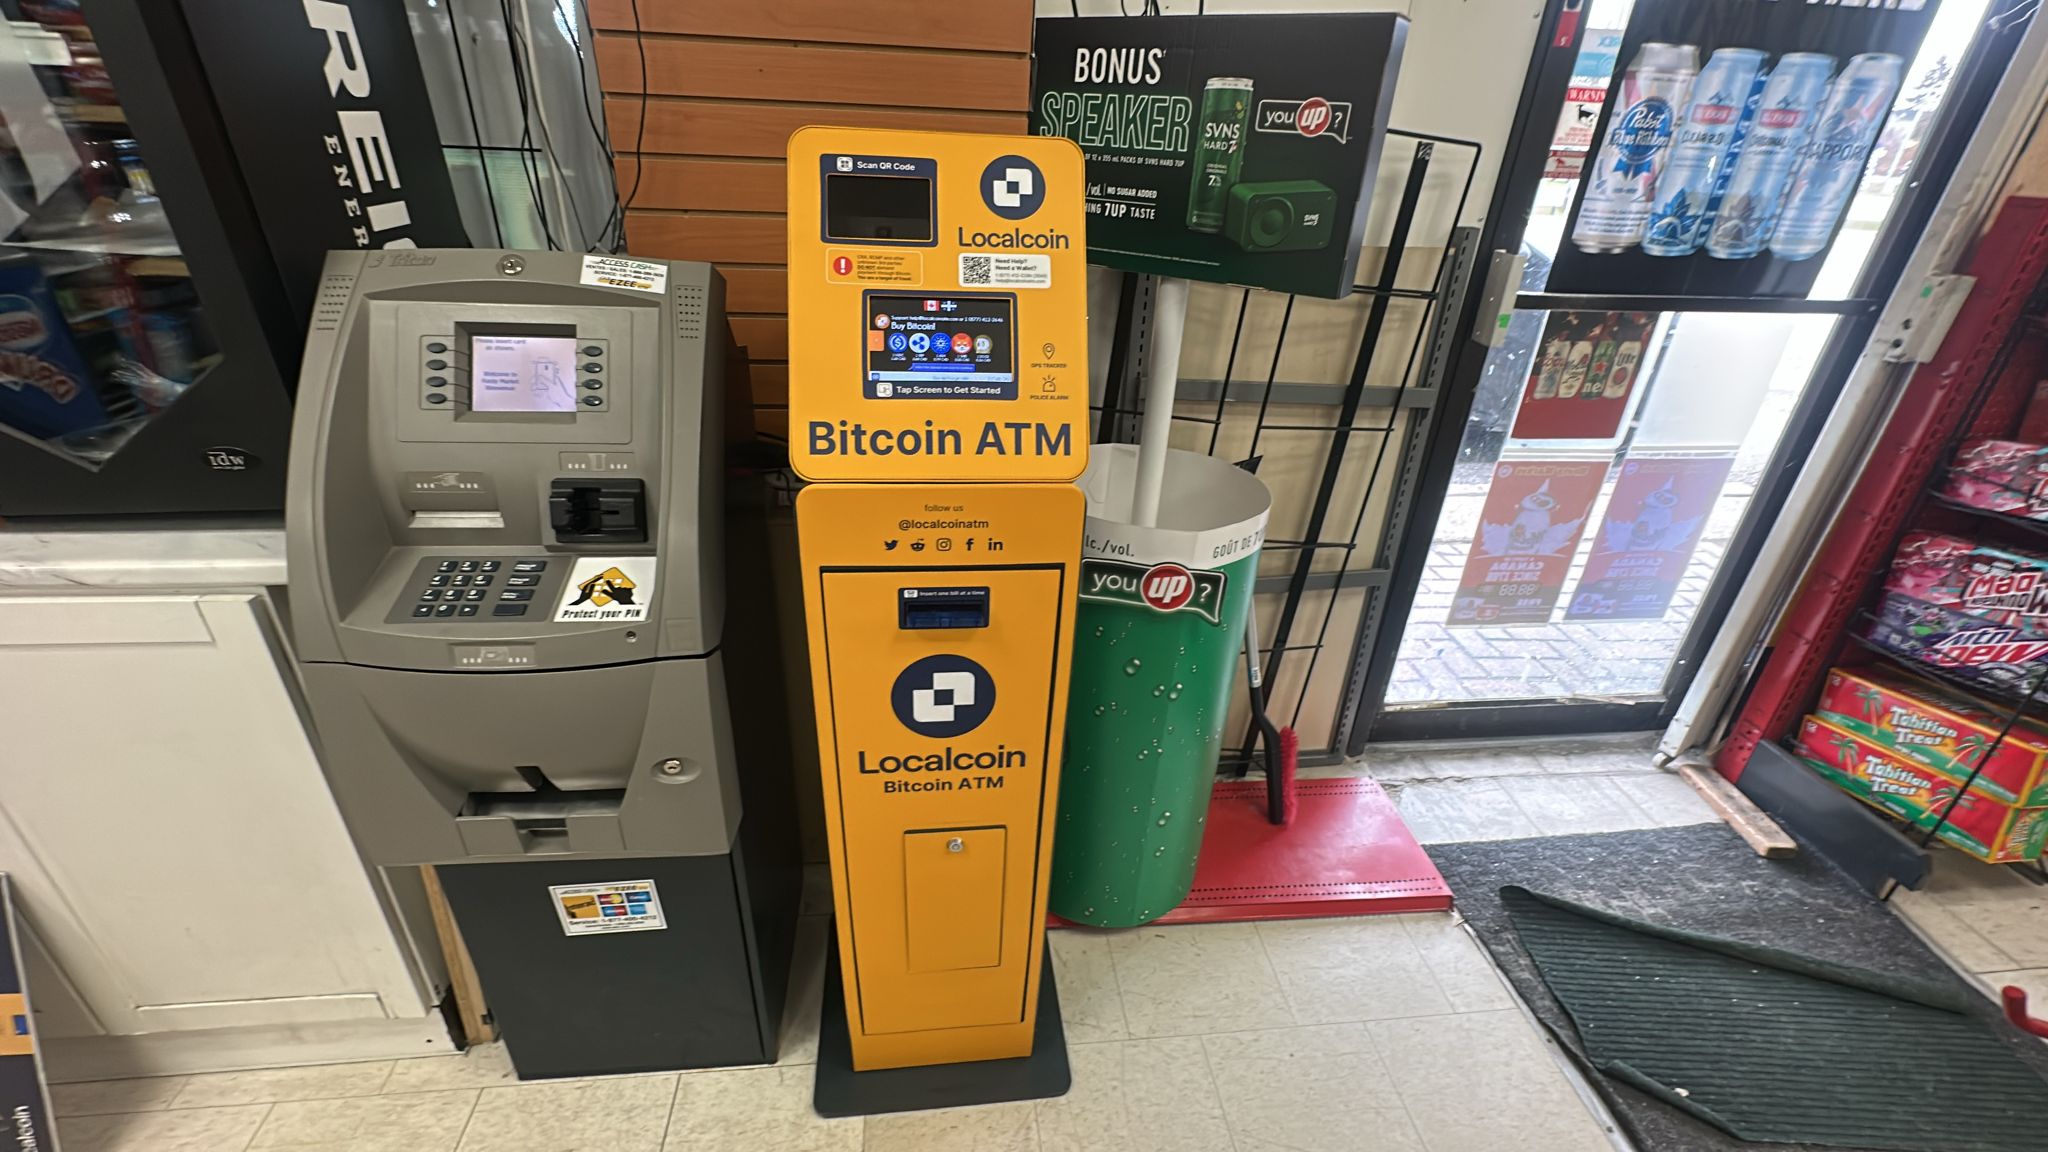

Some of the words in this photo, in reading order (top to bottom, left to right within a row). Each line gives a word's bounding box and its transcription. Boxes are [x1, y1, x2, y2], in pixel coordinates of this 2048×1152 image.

[1040, 91, 1193, 152] SPEAKER
[1264, 111, 1294, 127] you
[1301, 107, 1327, 131] up
[1204, 123, 1240, 139] SVNS
[1204, 142, 1228, 151] HARD
[857, 161, 878, 170] Scan
[880, 162, 893, 171] QR
[894, 163, 916, 171] Code
[1116, 187, 1136, 197] SUGAR
[1137, 189, 1158, 199] ADDED
[1104, 202, 1127, 218] 7UP
[1130, 206, 1156, 220] TASTE
[958, 226, 1070, 250] Localcoin
[599, 259, 630, 268] ACCESS
[891, 322, 906, 331] Buy
[906, 322, 937, 331] Bitcoin!
[896, 386, 912, 396] Tap
[913, 386, 942, 395] Screen
[943, 386, 953, 395] to
[954, 387, 970, 395] Get
[971, 387, 1002, 395] Started
[808, 419, 962, 456] Bitcoin
[975, 421, 1071, 456] ATM
[924, 503, 951, 512] follow
[898, 519, 990, 531] @localcoinatm
[1091, 573, 1137, 592] you
[1148, 576, 1188, 604] up
[1200, 583, 1213, 602] ?
[561, 609, 599, 620] Protect
[600, 609, 622, 621] your
[625, 608, 642, 619] PIN
[1890, 706, 1958, 738] Tahitian
[1895, 726, 1943, 746] Treat
[858, 744, 1026, 774] Localcoin
[1865, 754, 1933, 789] Tahitian
[884, 778, 953, 794] Bitcoin
[958, 775, 1004, 790] ATM
[1870, 776, 1918, 796] Treat
